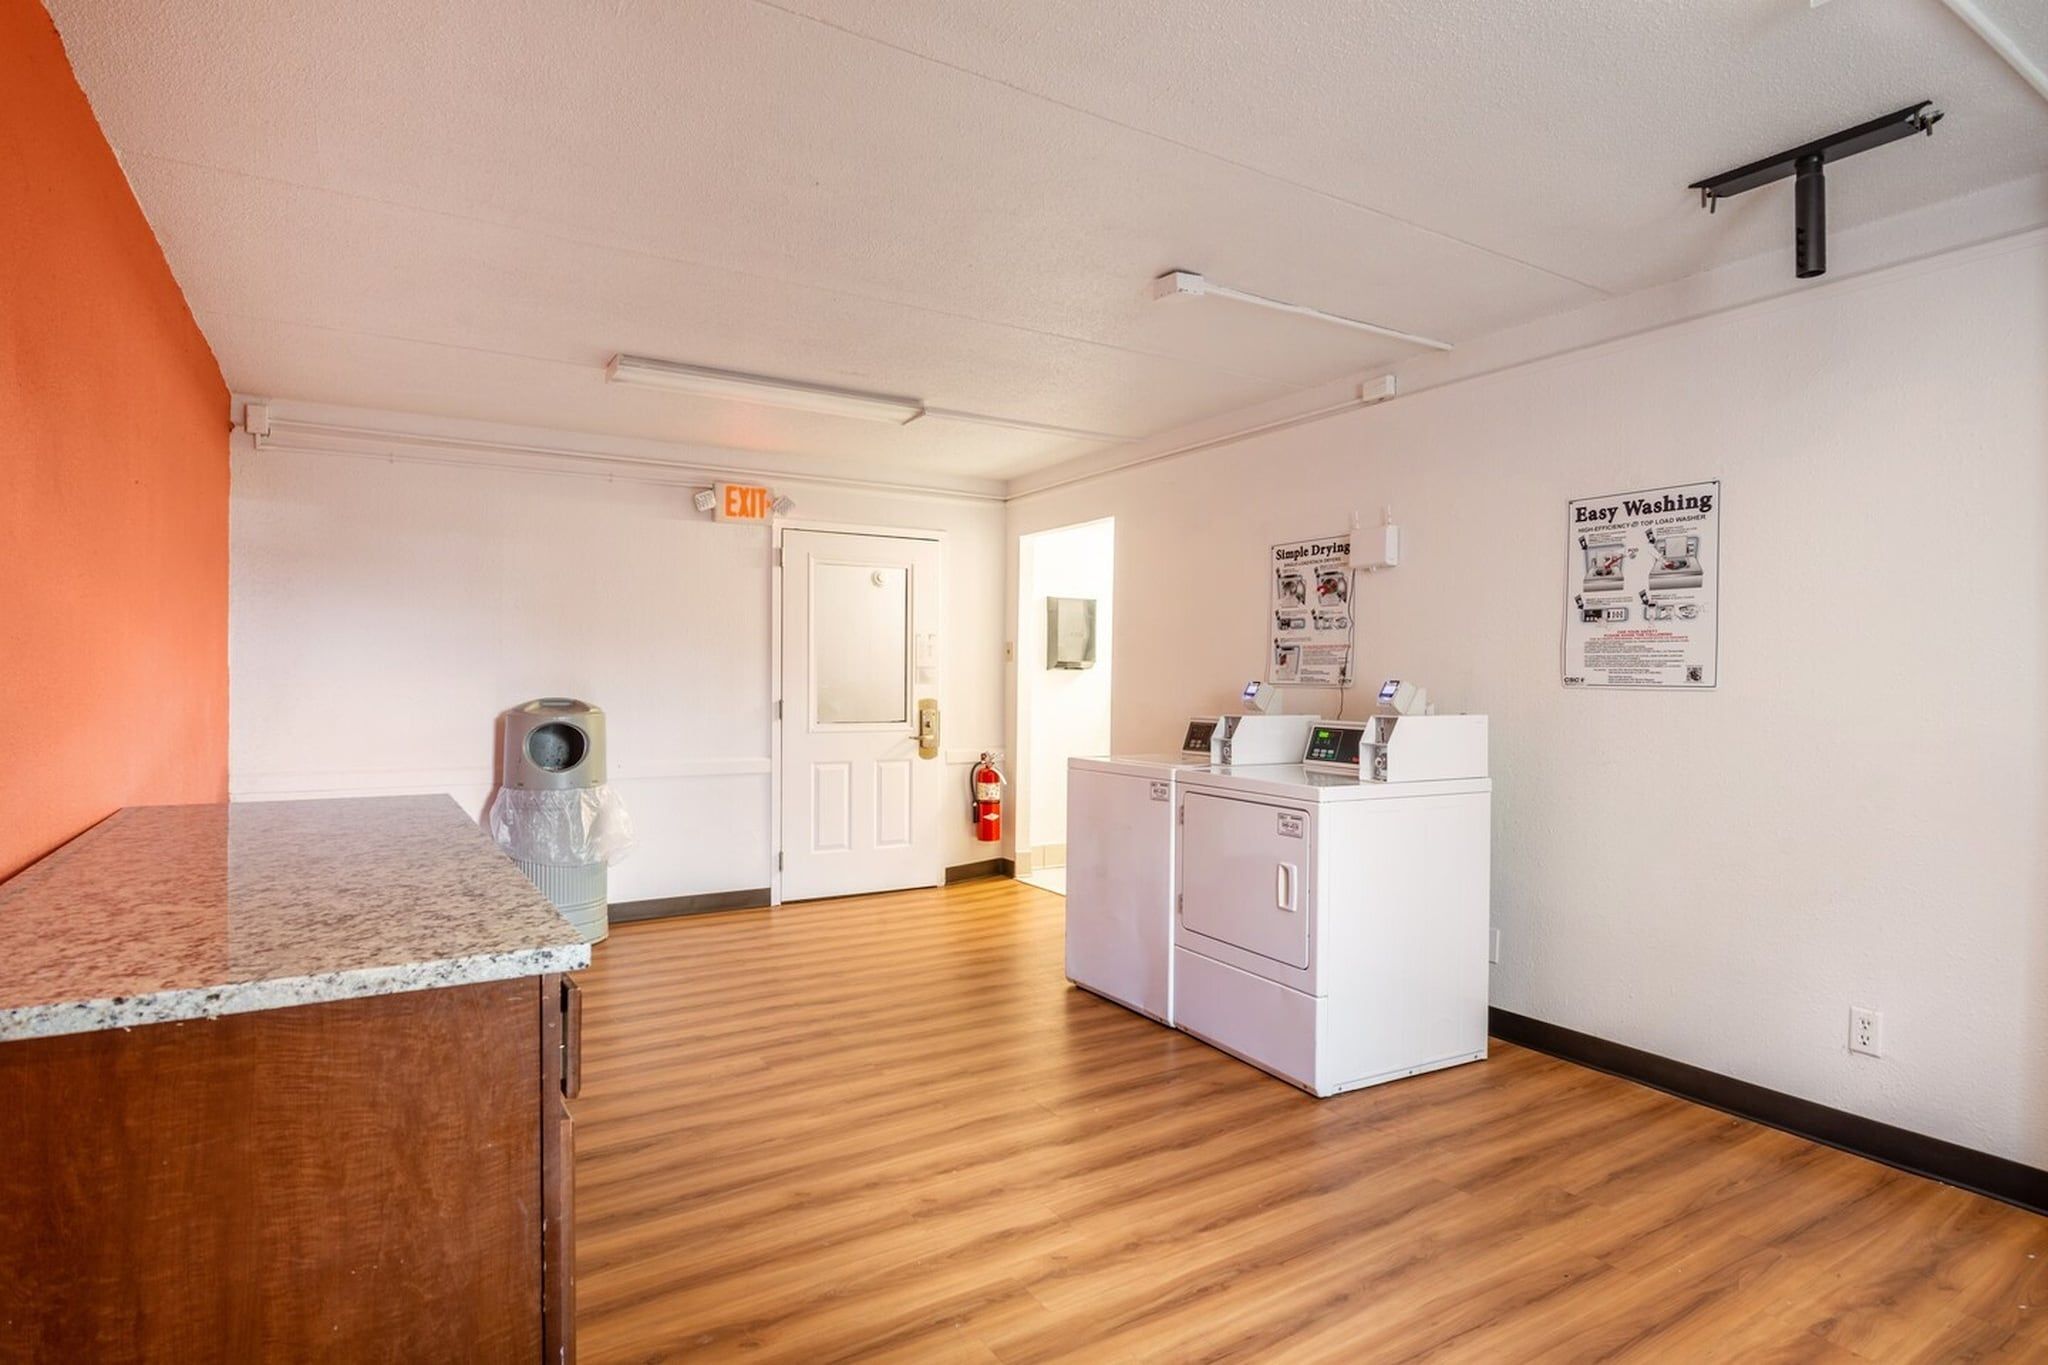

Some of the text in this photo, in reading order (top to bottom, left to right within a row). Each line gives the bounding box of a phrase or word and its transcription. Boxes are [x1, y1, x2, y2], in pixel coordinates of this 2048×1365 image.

[725, 485, 767, 519] EXIT
[1575, 494, 1713, 523] Easy Washing
[1655, 517, 1674, 525] LOAD
[1675, 514, 1706, 522] WASHER
[1275, 542, 1350, 561] Simple Drying
